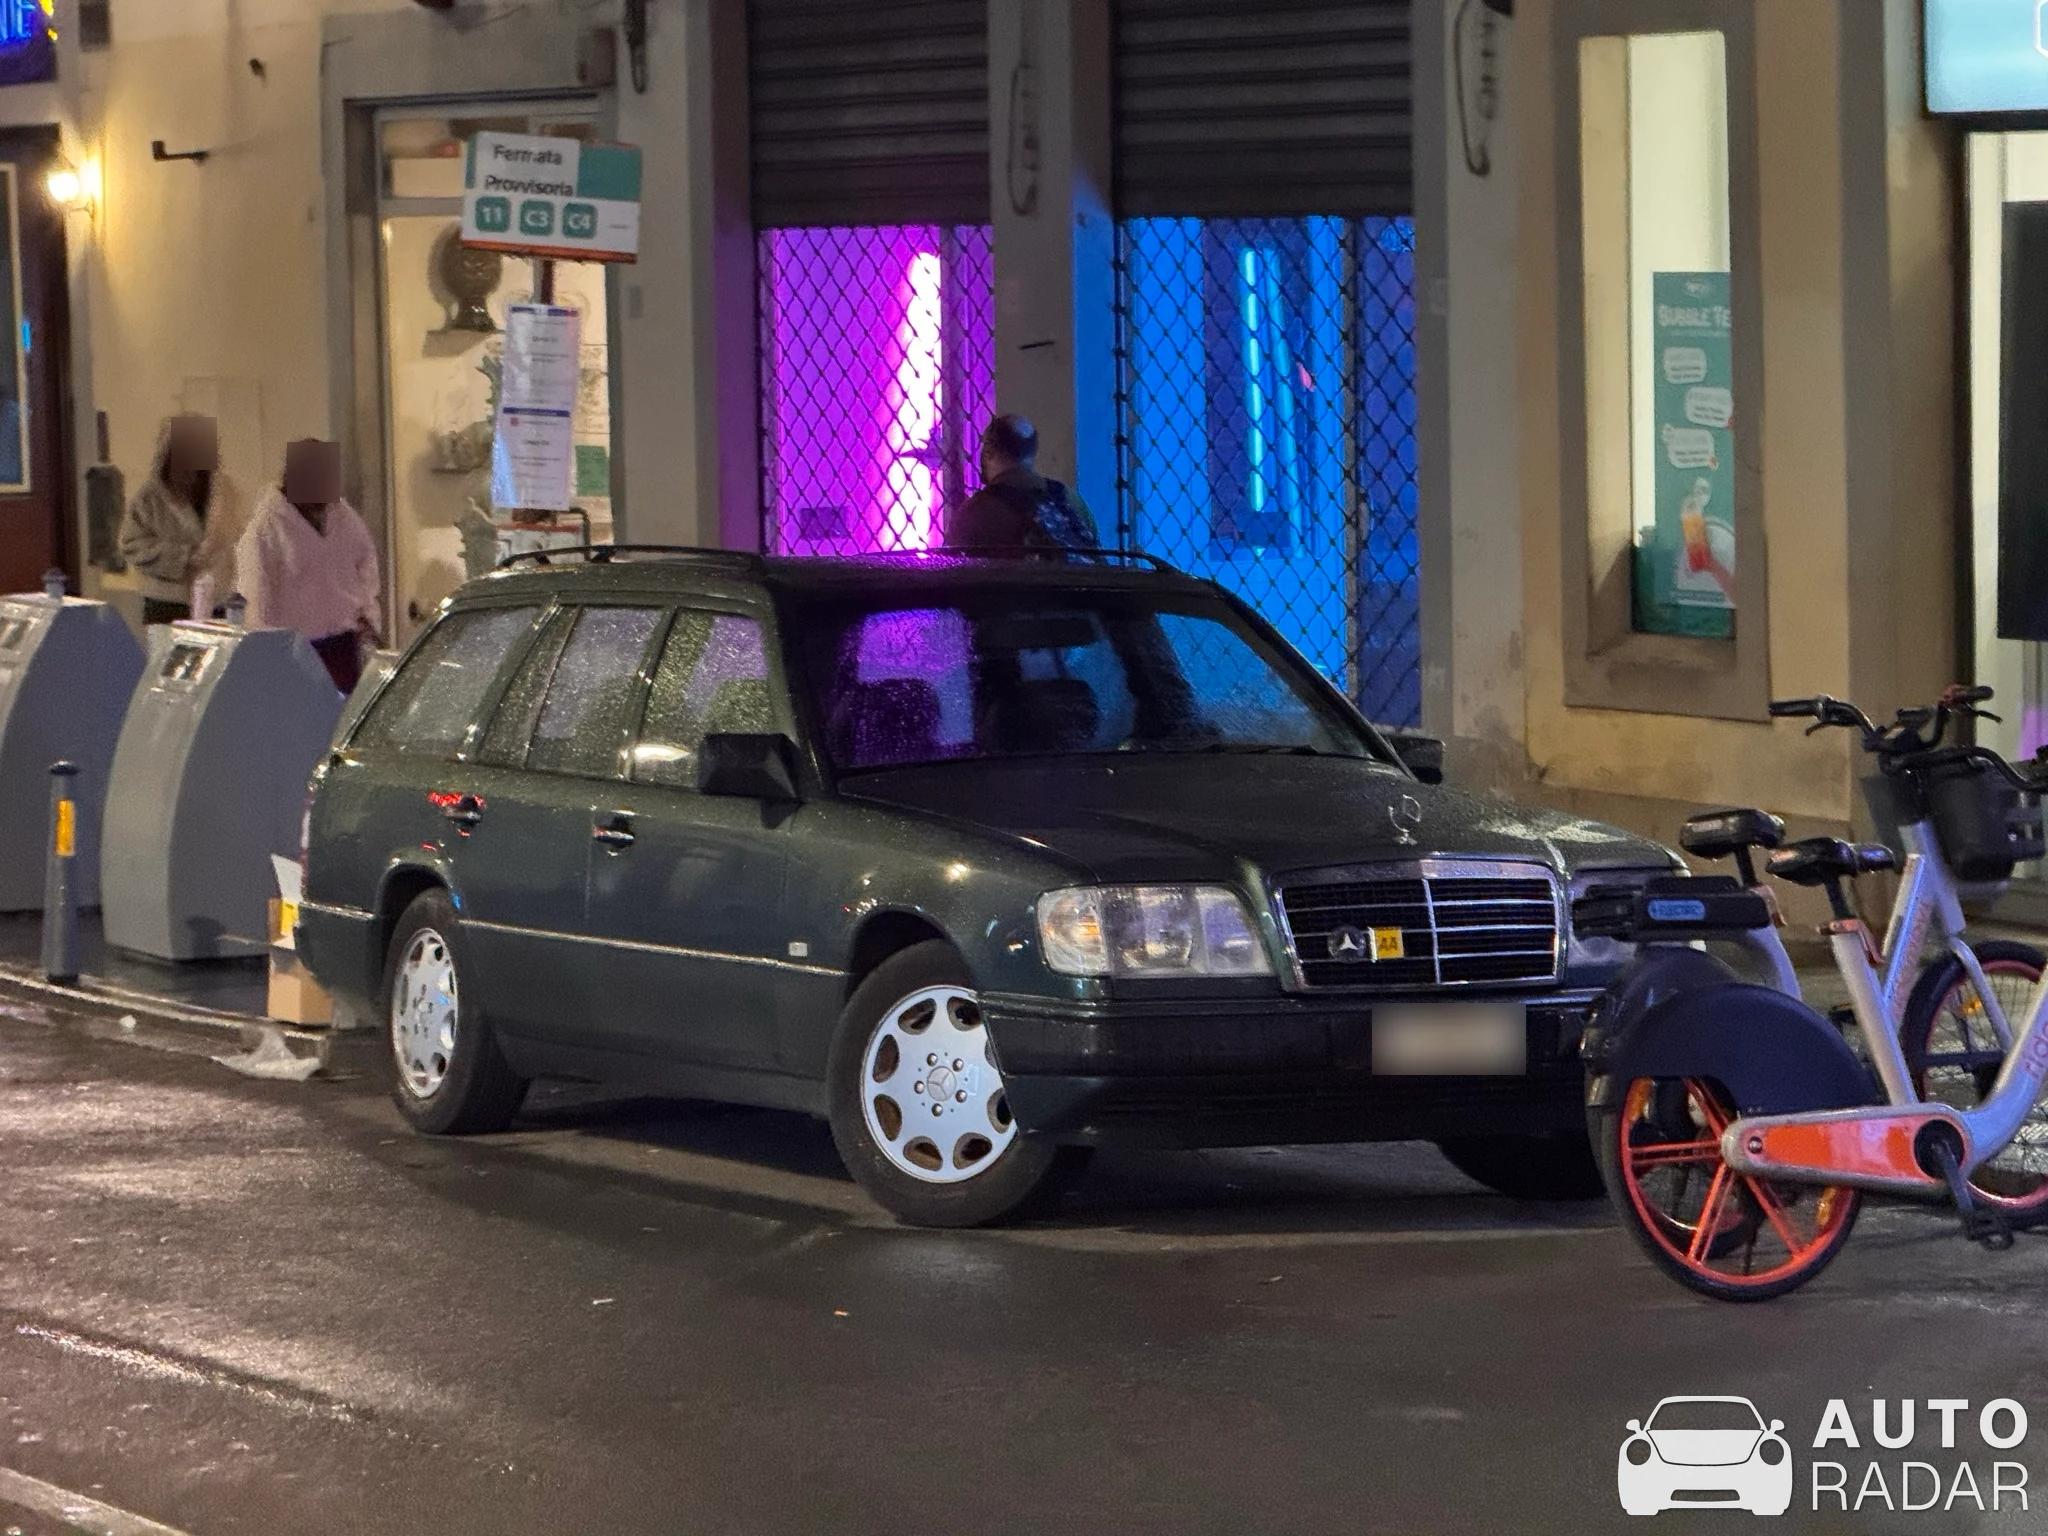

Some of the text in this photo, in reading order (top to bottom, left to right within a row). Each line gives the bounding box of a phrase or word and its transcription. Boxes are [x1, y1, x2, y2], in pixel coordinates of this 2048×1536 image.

[493, 144, 563, 166] Fermata
[485, 175, 573, 197] Provvisoria
[482, 206, 591, 230] 11 C3 C4
